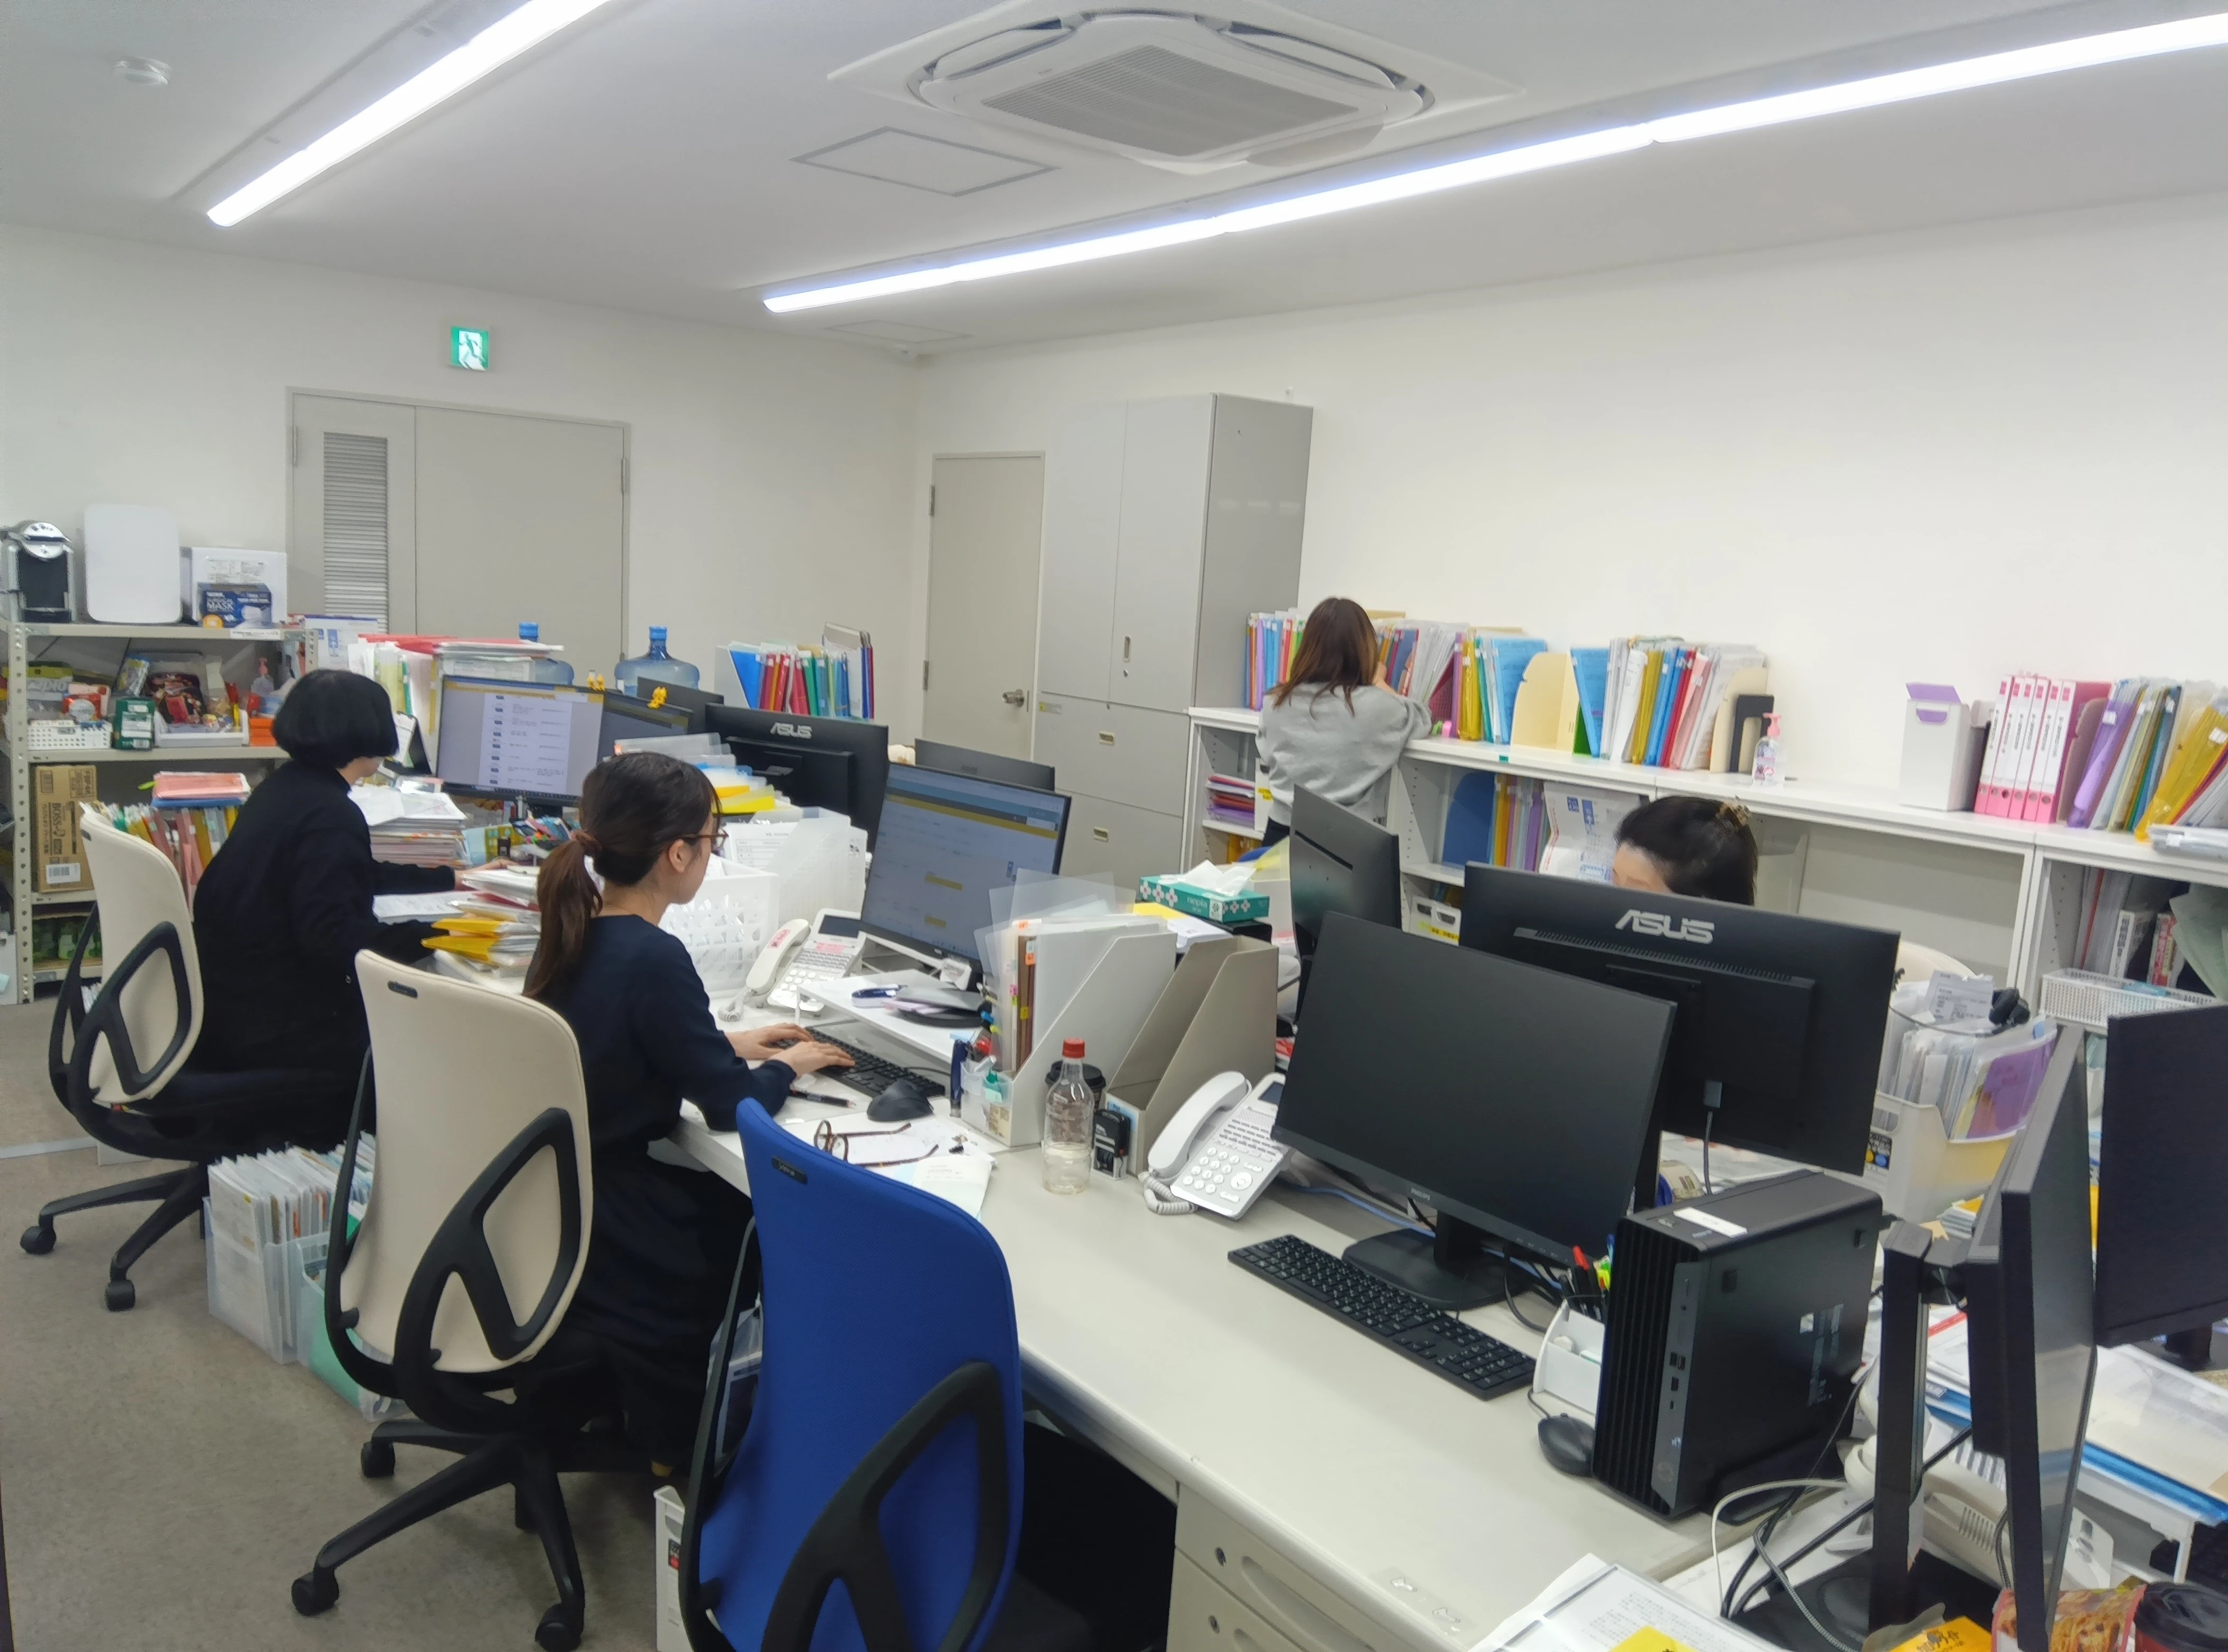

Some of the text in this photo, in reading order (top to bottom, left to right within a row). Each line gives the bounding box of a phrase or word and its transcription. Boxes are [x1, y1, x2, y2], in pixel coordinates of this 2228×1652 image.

[206, 601, 235, 610] MASK
[770, 722, 813, 739] ASUS
[52, 803, 62, 826] BOSS
[1187, 896, 1208, 908] nepia
[1615, 909, 1715, 945] ASUS
